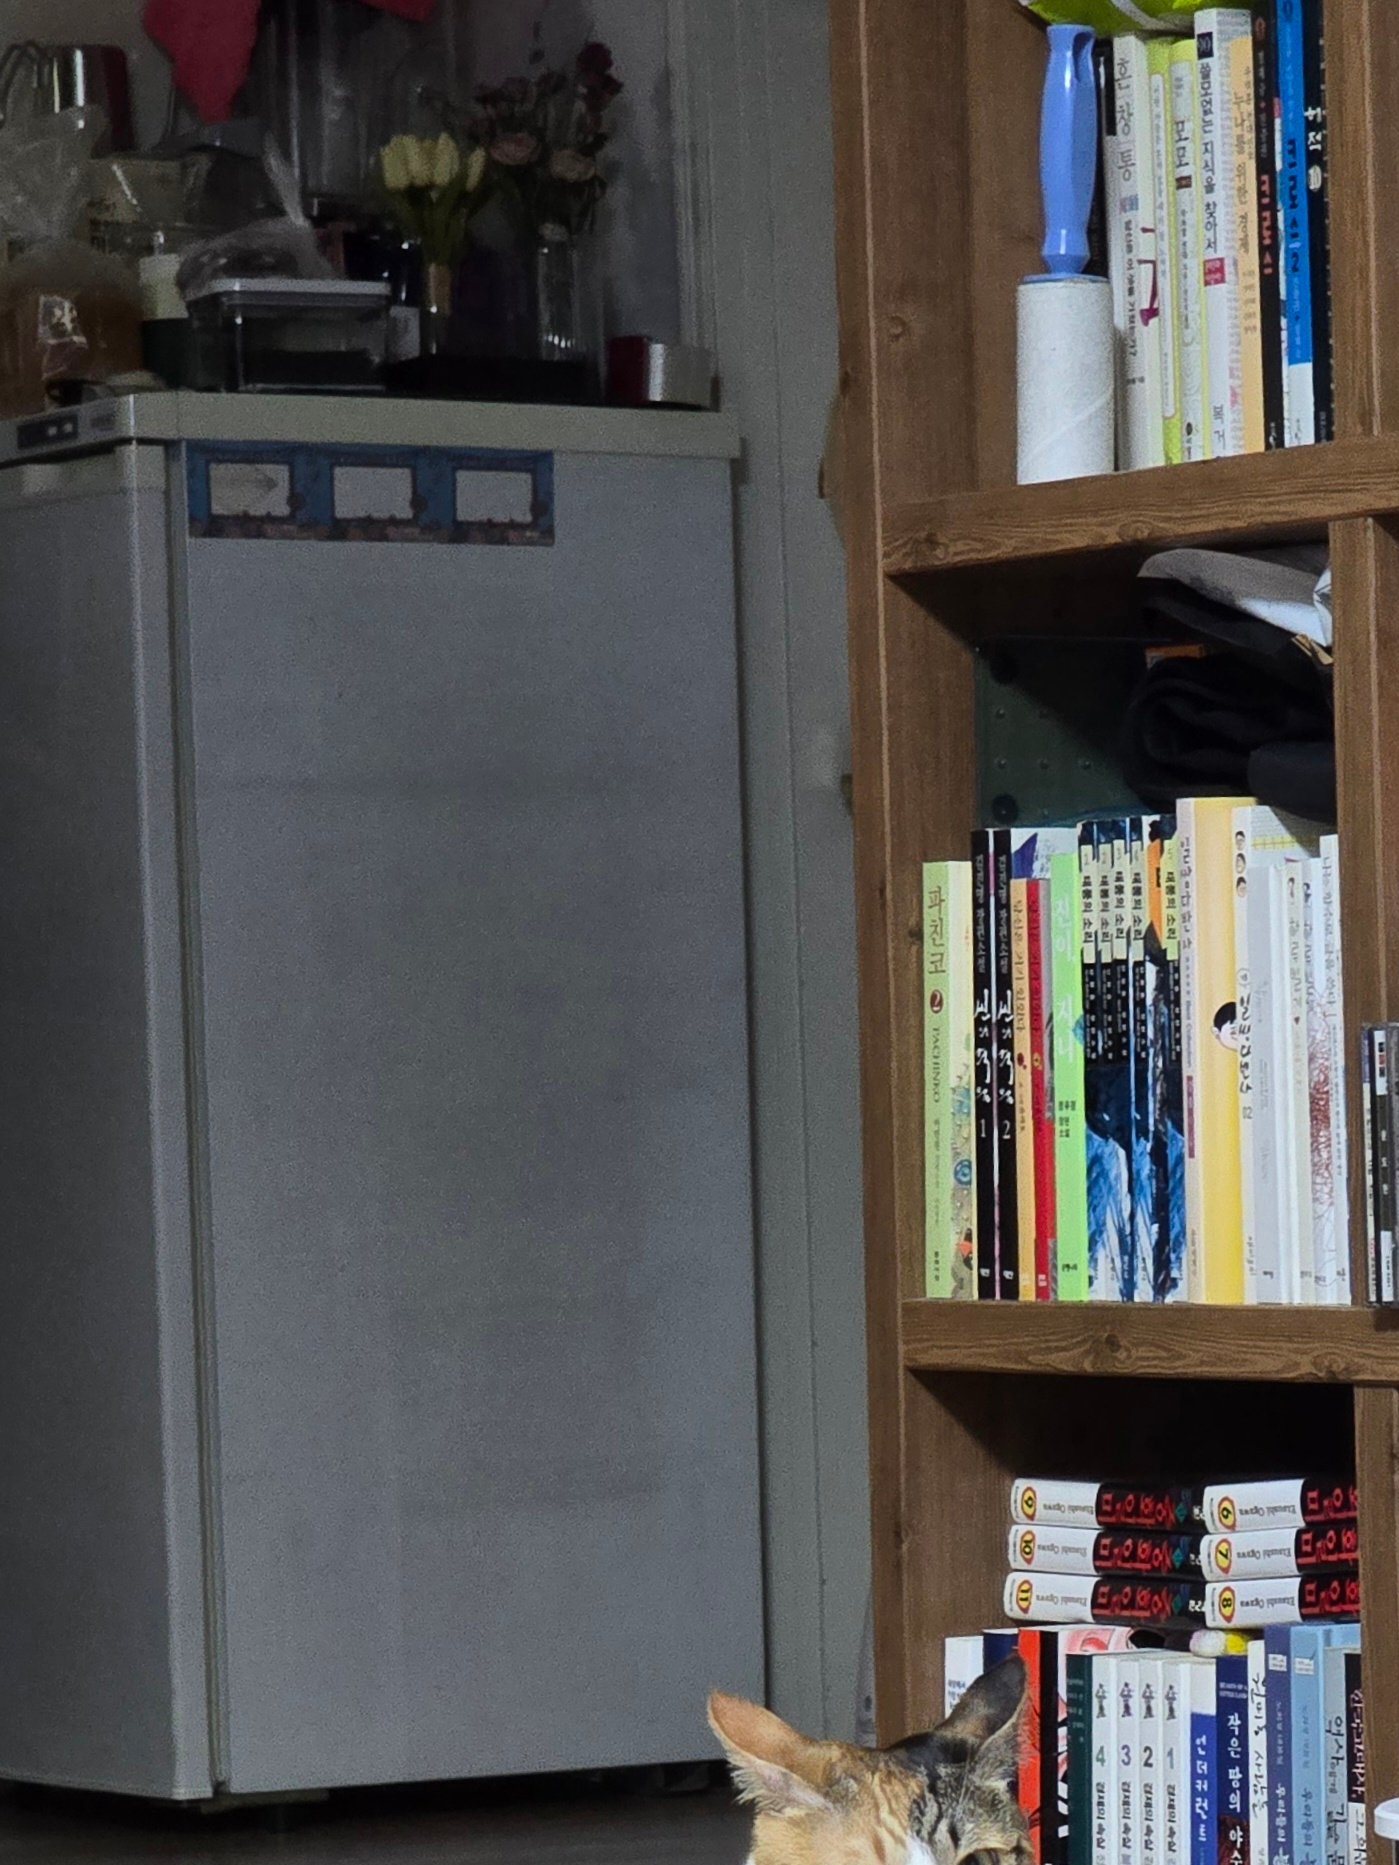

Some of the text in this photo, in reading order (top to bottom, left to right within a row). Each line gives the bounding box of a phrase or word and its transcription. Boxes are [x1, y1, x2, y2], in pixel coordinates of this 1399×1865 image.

[927, 887, 946, 1104] 파친코 PACHINKO
[1024, 1496, 1035, 1512] 9
[1222, 1507, 1232, 1520] 6
[1021, 1539, 1035, 1556] 10
[1218, 1547, 1229, 1563] 7
[1019, 1588, 1031, 1605] 11
[1221, 1597, 1233, 1612] 8
[1227, 1712, 1243, 1759] 작은
[1096, 1745, 1106, 1767] 4
[1121, 1744, 1131, 1766] 3
[1143, 1746, 1154, 1851] 2 속살
[1228, 1766, 1242, 1813] 땅의
[1252, 1750, 1268, 1819] 사람들
[1276, 1782, 1286, 1842] 우리들의
[1302, 1787, 1313, 1847] 우리들의
[1096, 1822, 1106, 1850] 속살
[1121, 1822, 1132, 1850] 속살
